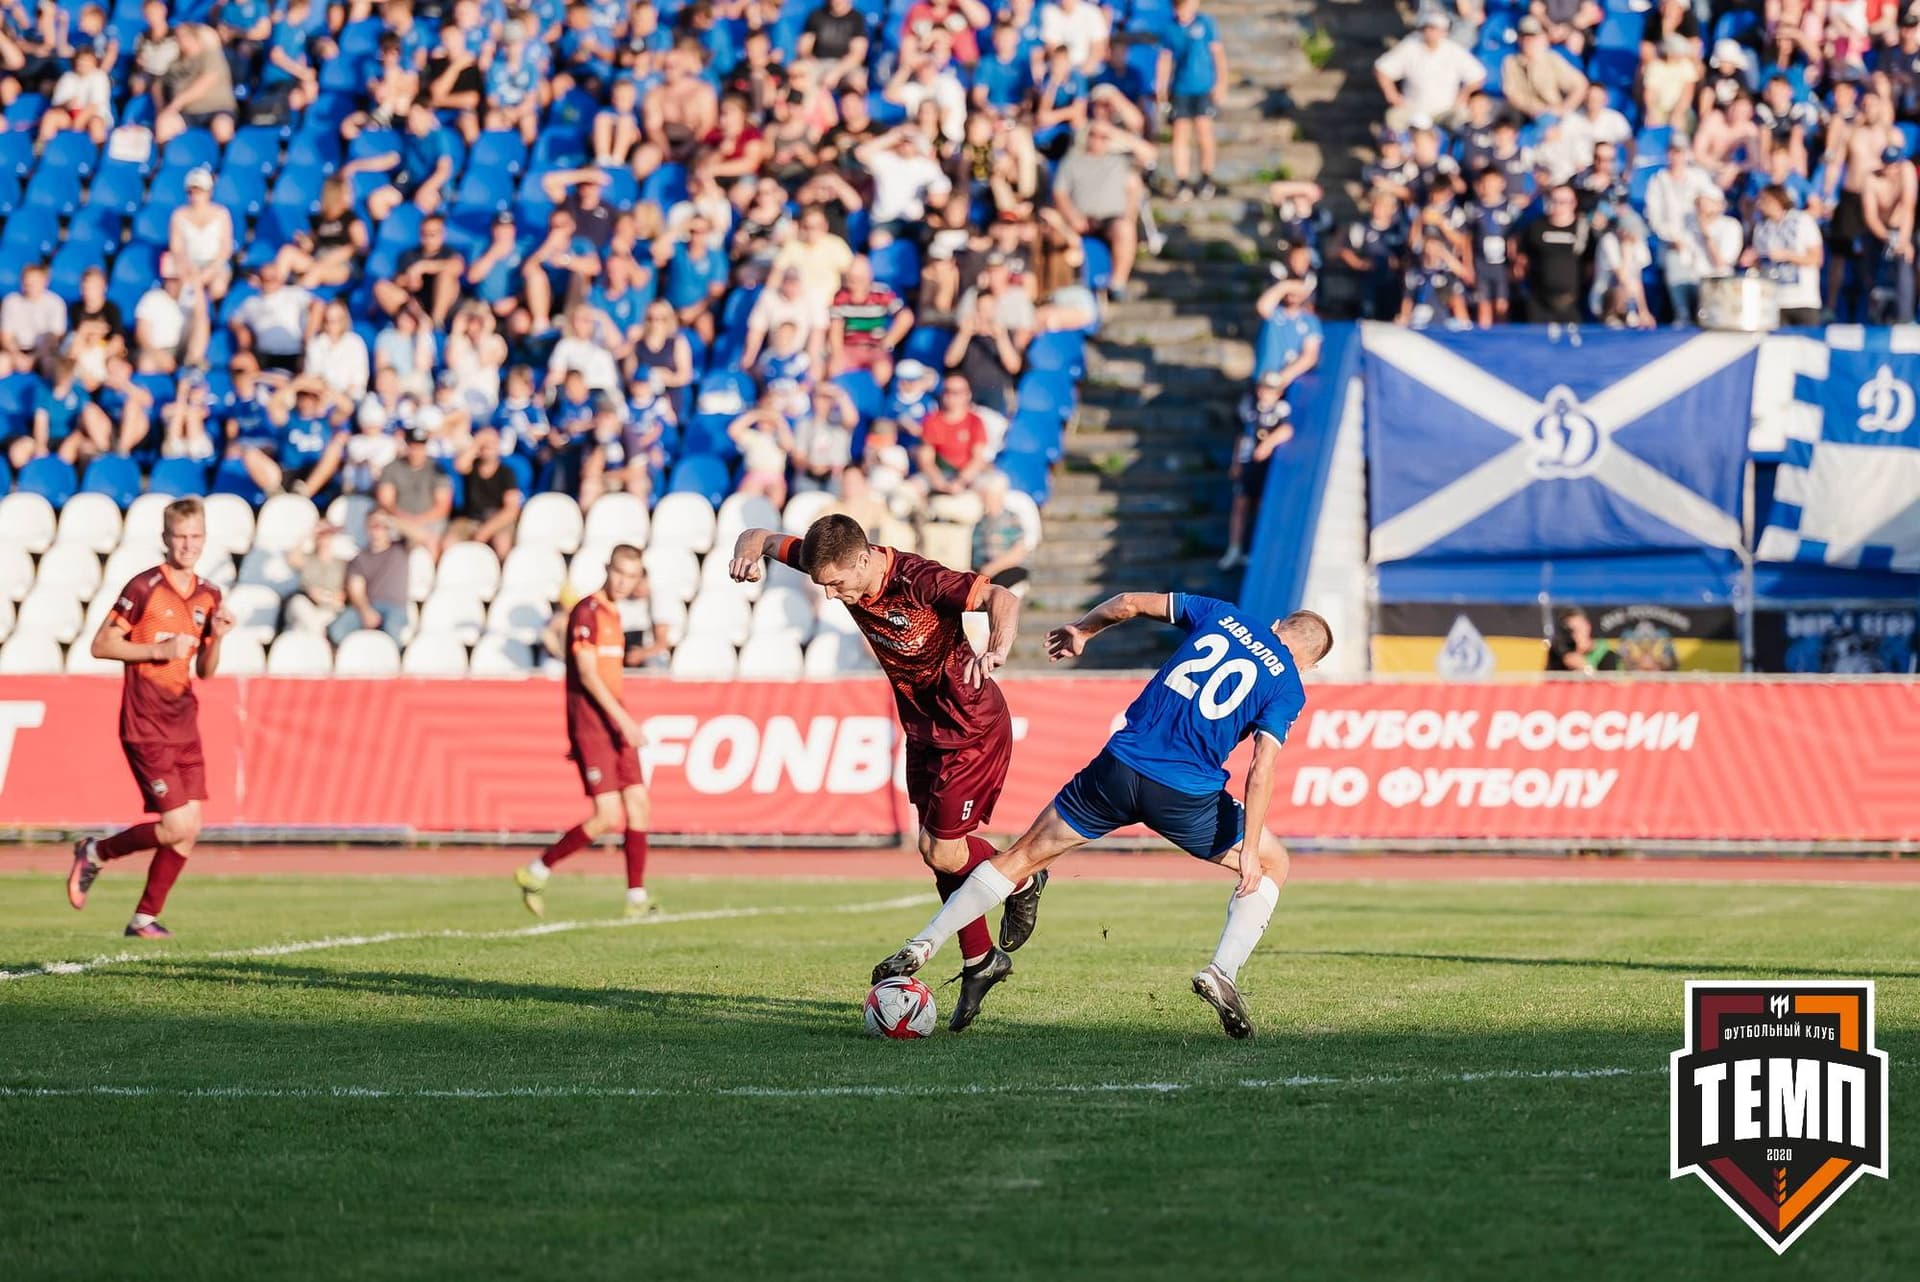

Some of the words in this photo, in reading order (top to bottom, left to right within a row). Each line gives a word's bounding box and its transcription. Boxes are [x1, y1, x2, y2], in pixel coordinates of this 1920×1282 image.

[1218, 616, 1285, 677] ЗАВЬЯЛОВ
[1164, 633, 1258, 720] 20
[1307, 710, 1480, 750] КУБОК
[1486, 710, 1699, 751] РОССИИ
[1291, 766, 1369, 807] ПО
[1377, 766, 1619, 808] ФУТБОЛУ
[961, 799, 974, 821] 5
